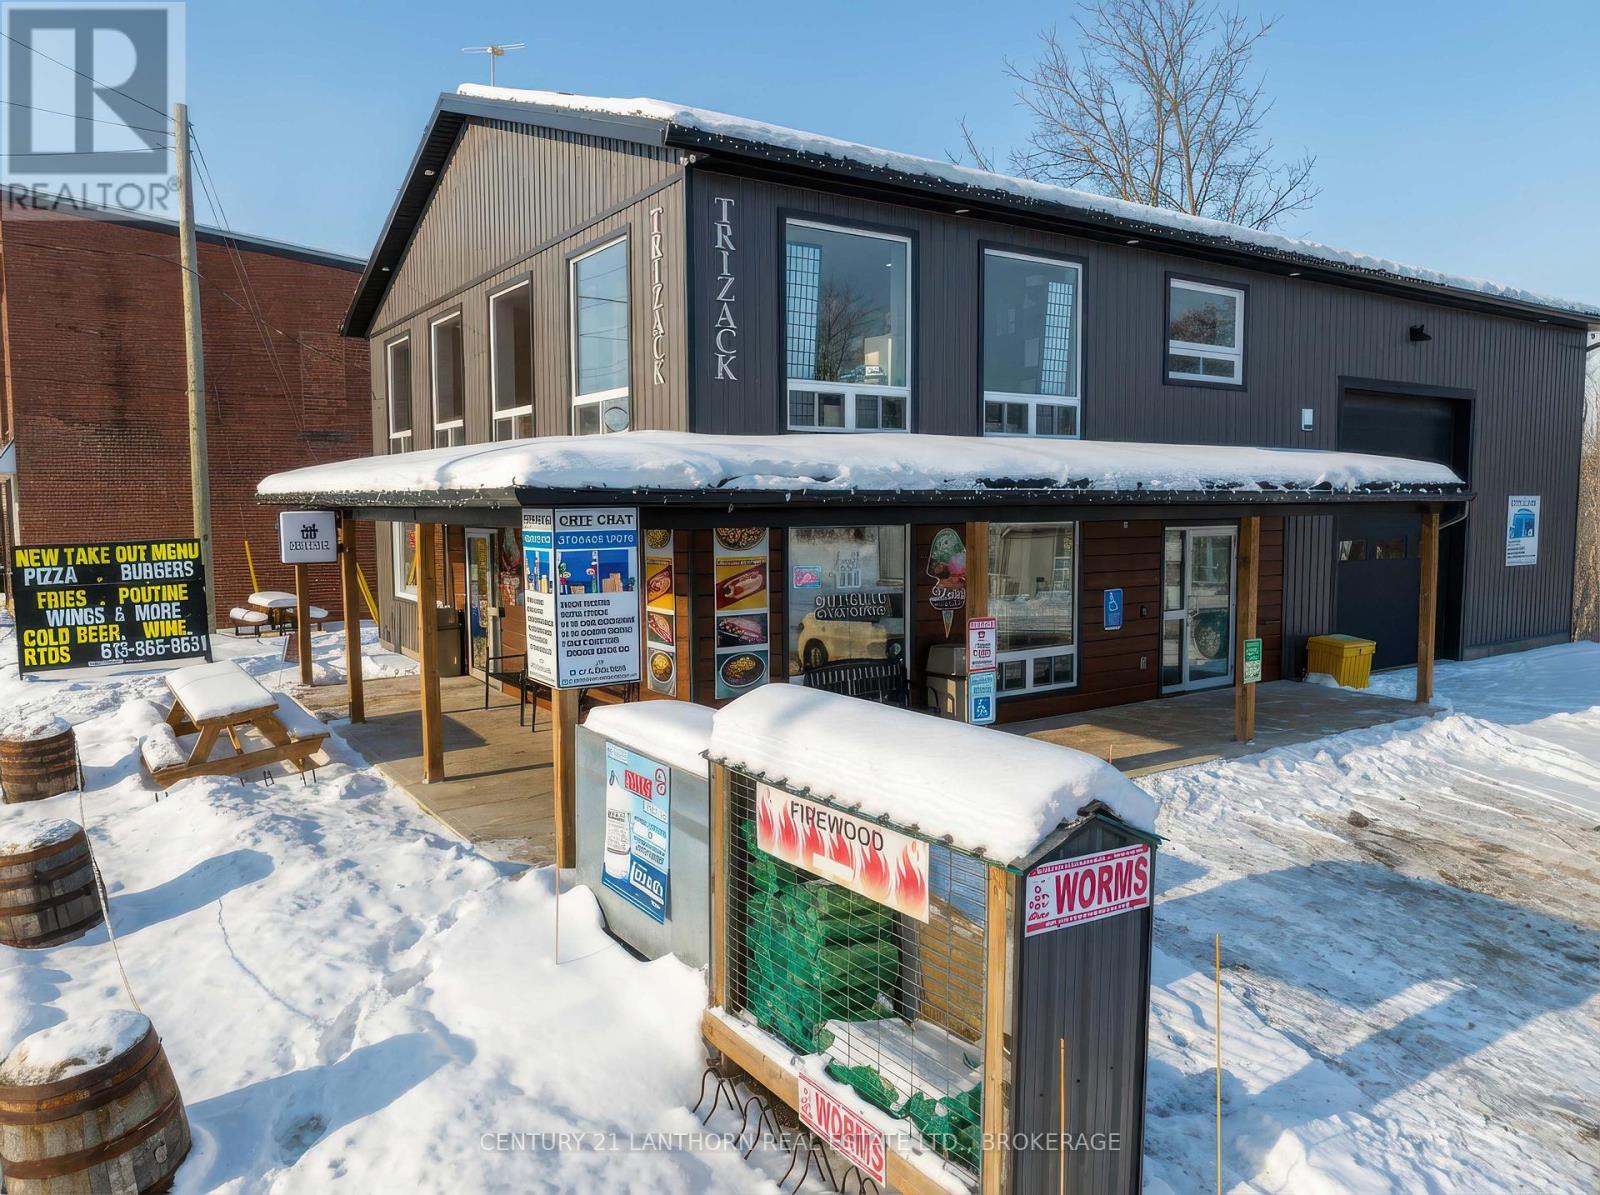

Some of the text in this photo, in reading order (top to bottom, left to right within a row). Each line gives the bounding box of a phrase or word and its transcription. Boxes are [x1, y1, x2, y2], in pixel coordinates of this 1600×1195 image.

[650, 207, 665, 385] TRIZACK
[714, 197, 738, 381] TRIZACK
[597, 514, 633, 525] CHAT
[15, 543, 199, 567] NEW TAKE OUT MENU
[24, 561, 194, 586] PIZZA BURGERS
[37, 584, 188, 609] FRIES POUTINE
[46, 602, 181, 627] WINGS & MORE
[24, 628, 70, 647] COLD
[25, 646, 71, 666] RTDS
[791, 800, 884, 852] FIREWOOD
[1055, 856, 1148, 914] WORMS
[816, 1092, 884, 1172] WORMS
